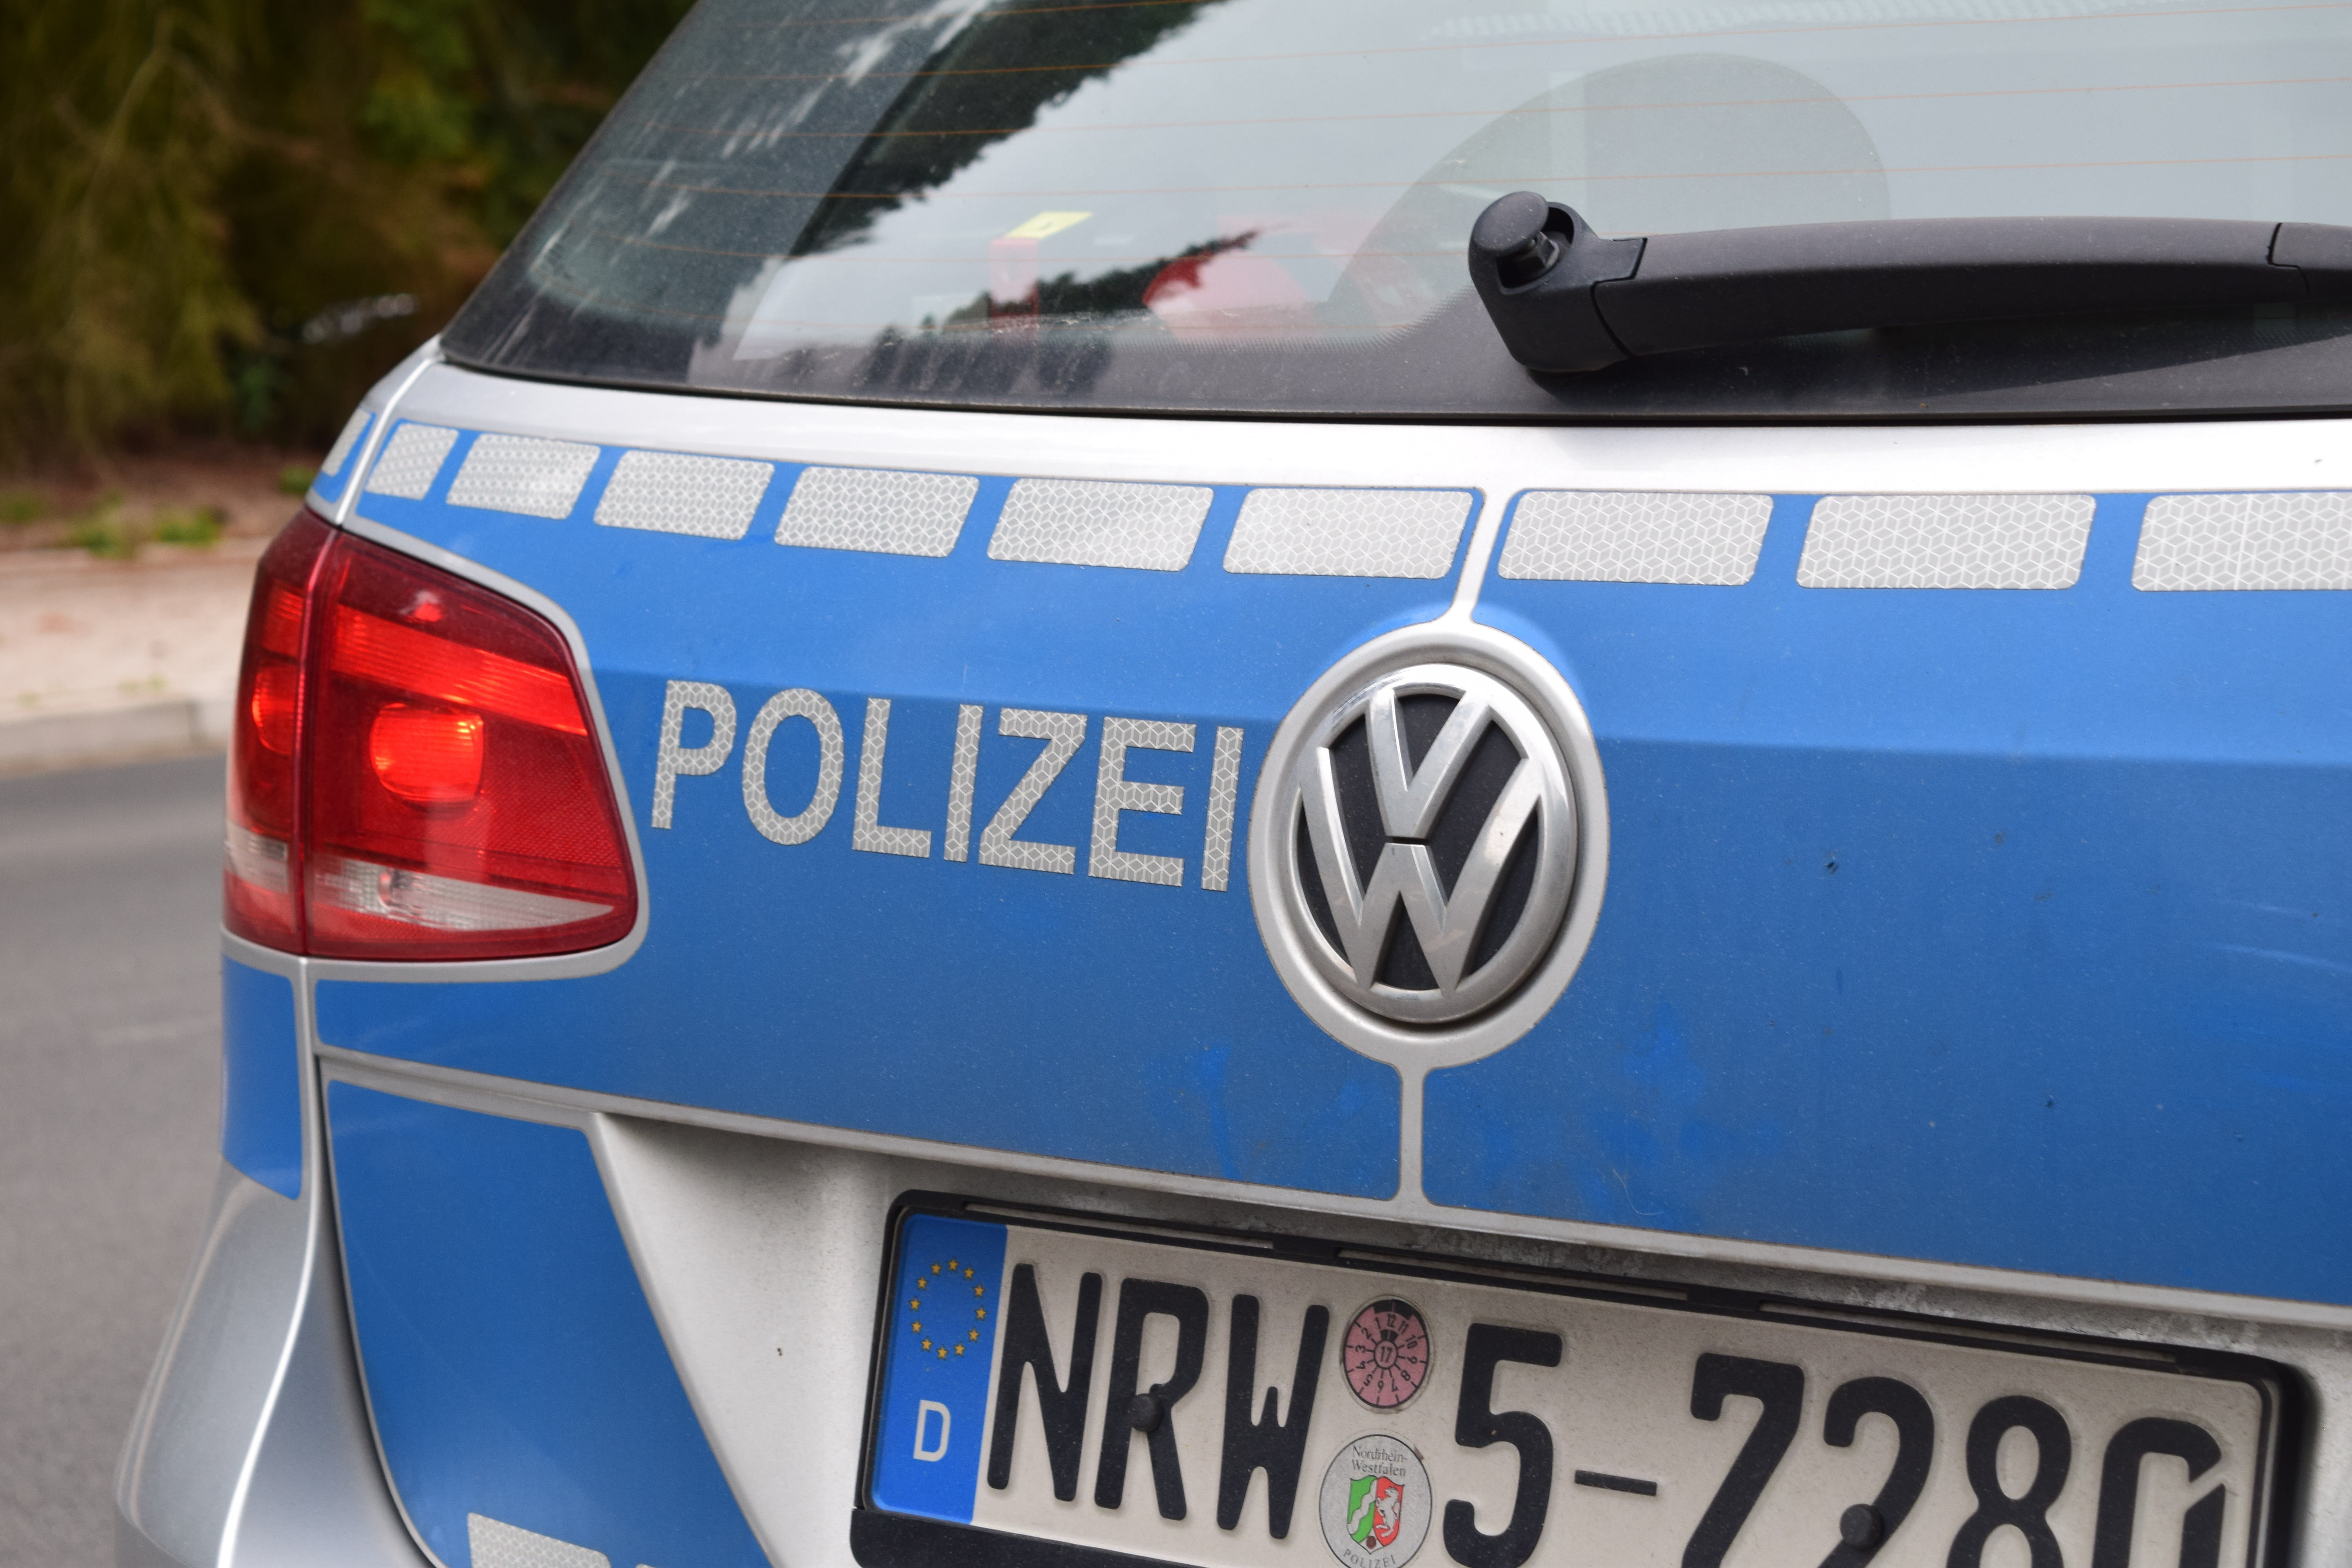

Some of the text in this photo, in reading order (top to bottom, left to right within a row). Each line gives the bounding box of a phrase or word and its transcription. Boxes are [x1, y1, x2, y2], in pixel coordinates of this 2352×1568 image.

[652, 680, 1244, 892] POLIZEI
[1294, 682, 1544, 996] VW
[1374, 1317, 1381, 1329] 1
[1387, 1314, 1396, 1328] 12
[1397, 1320, 1409, 1335] 11
[1361, 1327, 1372, 1339] 2
[1406, 1334, 1418, 1349] 10
[1355, 1345, 1366, 1354] 3
[1380, 1346, 1393, 1363] 17
[1356, 1361, 1366, 1369] 4
[1406, 1356, 1417, 1364] 9
[1363, 1374, 1374, 1387] 5
[1401, 1370, 1410, 1381] 8
[1392, 1378, 1398, 1392] 7
[987, 1263, 1330, 1539] NRW
[913, 1399, 952, 1463] D
[1352, 1445, 1408, 1463] Nordrhein-
[1351, 1459, 1406, 1477] Westfalen
[1343, 1548, 1396, 1568] POLIZEI
